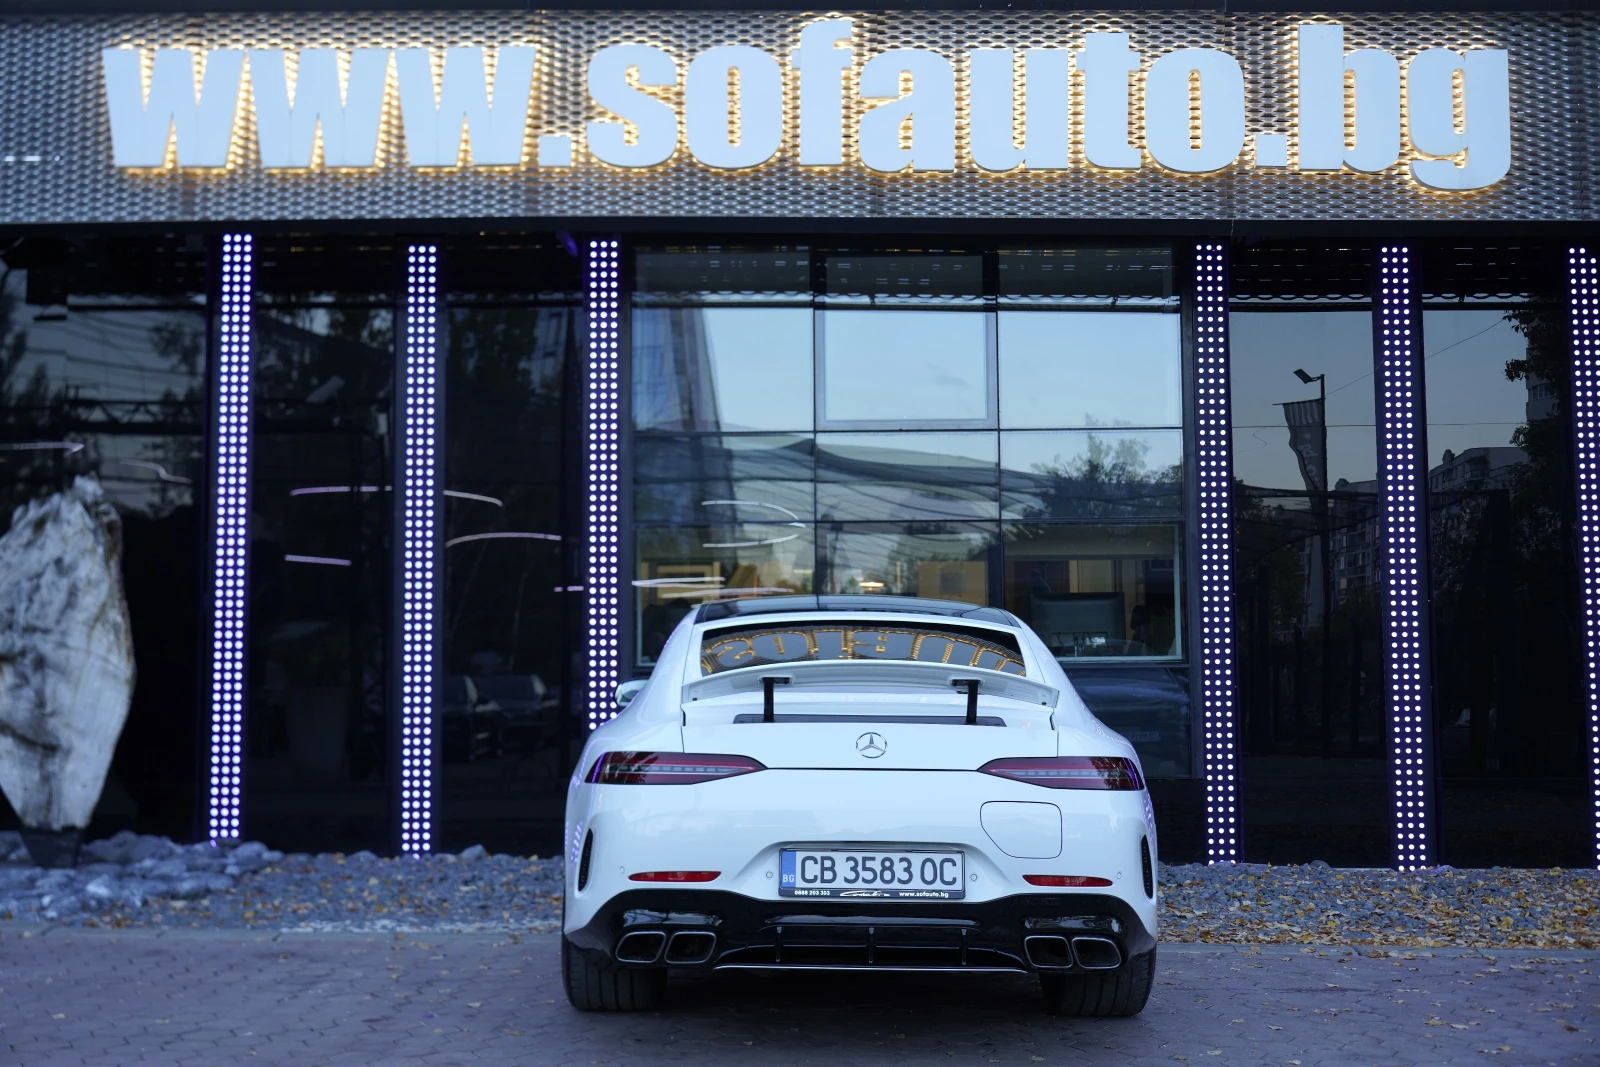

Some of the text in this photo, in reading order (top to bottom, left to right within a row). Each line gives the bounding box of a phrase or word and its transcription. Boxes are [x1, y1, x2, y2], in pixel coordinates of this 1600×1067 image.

[102, 17, 1511, 191] www.sofauto.bg
[782, 874, 795, 883] BG
[800, 856, 837, 883] CB
[843, 857, 913, 885] 3583
